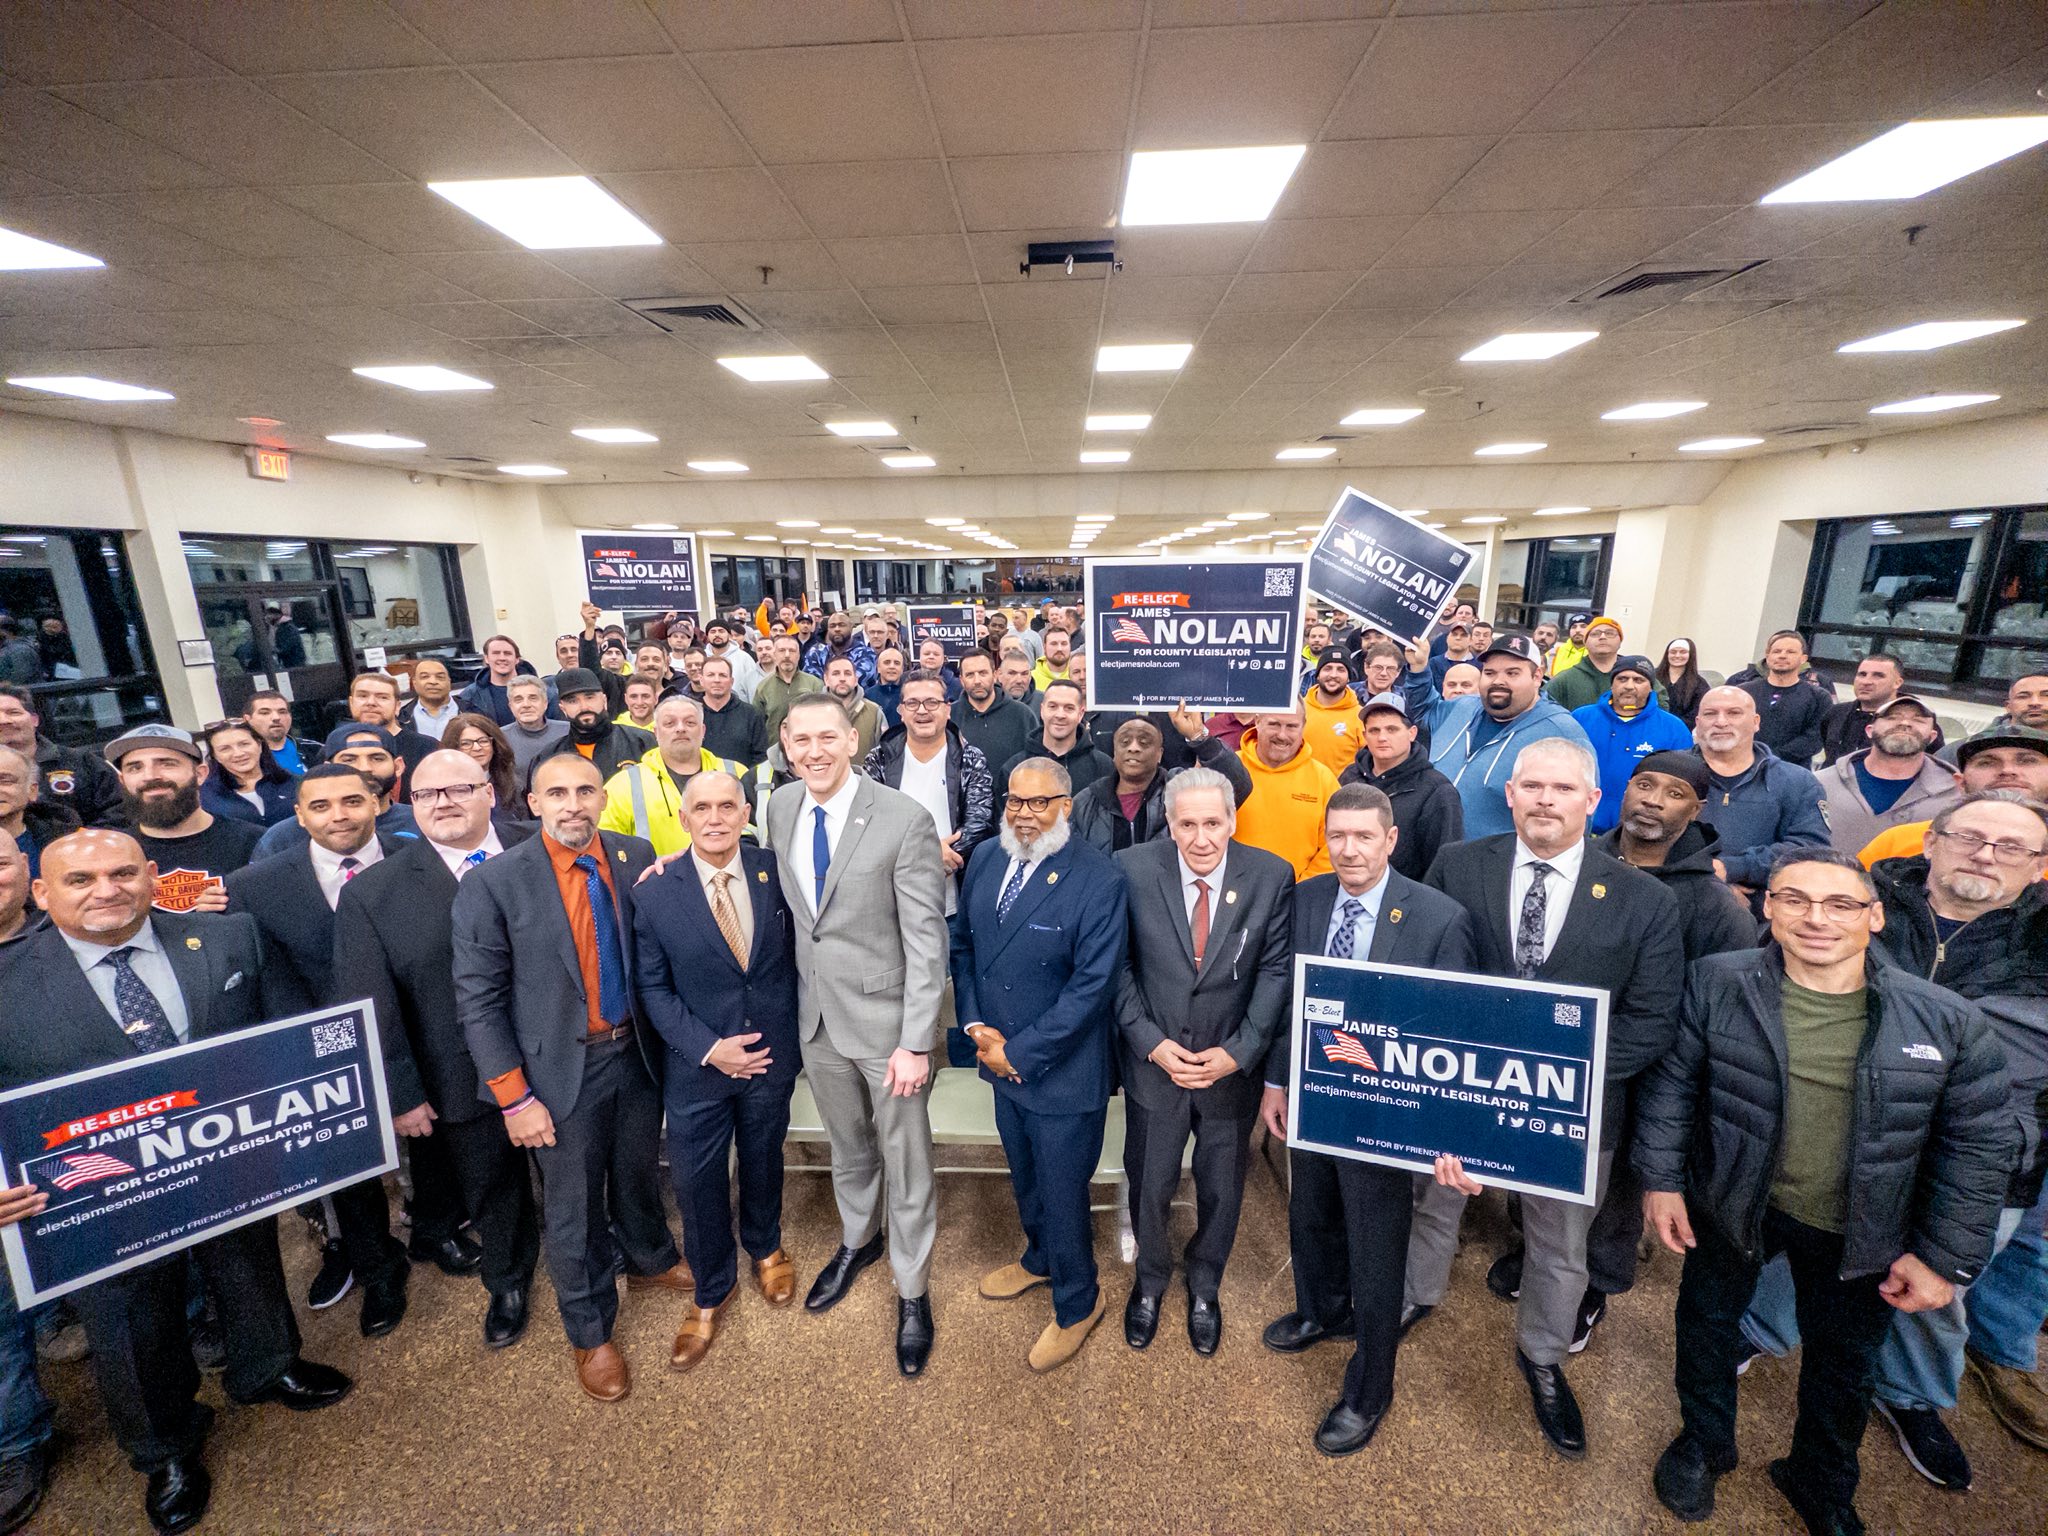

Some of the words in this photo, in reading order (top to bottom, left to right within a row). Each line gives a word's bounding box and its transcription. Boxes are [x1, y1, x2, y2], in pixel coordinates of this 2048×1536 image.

[261, 454, 288, 479] EXIT
[1349, 528, 1377, 546] JAMES
[619, 563, 686, 578] NOLAN
[1353, 563, 1379, 581] COUNTY
[1379, 577, 1416, 600] LEGISLATOR
[1358, 545, 1445, 602] NOLAN
[1123, 594, 1178, 604] RE-ELECT
[1130, 608, 1171, 618] JAMES
[930, 626, 971, 637] NOLAN
[1154, 618, 1280, 645] NOLAN
[1100, 660, 1180, 669] electjamesnolan.com
[1133, 648, 1151, 656] FOR
[1153, 648, 1192, 656] COUNTY
[1193, 648, 1250, 656] LEGISLATOR
[161, 874, 199, 885] MOTOR
[163, 895, 199, 909] CYCLE
[1307, 1004, 1341, 1016] Re-Elect
[1342, 1020, 1399, 1038] JAMES
[1384, 1040, 1576, 1102] NOLAN
[1304, 1082, 1420, 1109] electjamesnolan.com
[1352, 1074, 1379, 1087] FOR
[1381, 1078, 1439, 1096] COUNTY
[1441, 1087, 1529, 1112] LEGISLATOR
[68, 1095, 176, 1137] RE-ELECT
[138, 1075, 351, 1168] NOLAN
[88, 1116, 167, 1149] JAMES
[104, 1177, 142, 1197] FOR
[145, 1152, 216, 1182] COUNTY
[219, 1121, 314, 1158] LEGISLATOR
[1356, 1136, 1374, 1145] PAID
[1376, 1140, 1392, 1149] FOR
[1393, 1143, 1404, 1151] BY
[1405, 1145, 1440, 1157] FRIENDS
[1484, 1160, 1515, 1172] NOLAN
[36, 1174, 199, 1236] electjamesnolan.com
[116, 1241, 143, 1256] PAID
[145, 1231, 168, 1245] FOR
[170, 1225, 185, 1236] BY
[187, 1208, 233, 1229] FRIENDS
[234, 1201, 249, 1212] OF
[251, 1190, 282, 1207] JAMES
[283, 1177, 318, 1194] NOLAN
